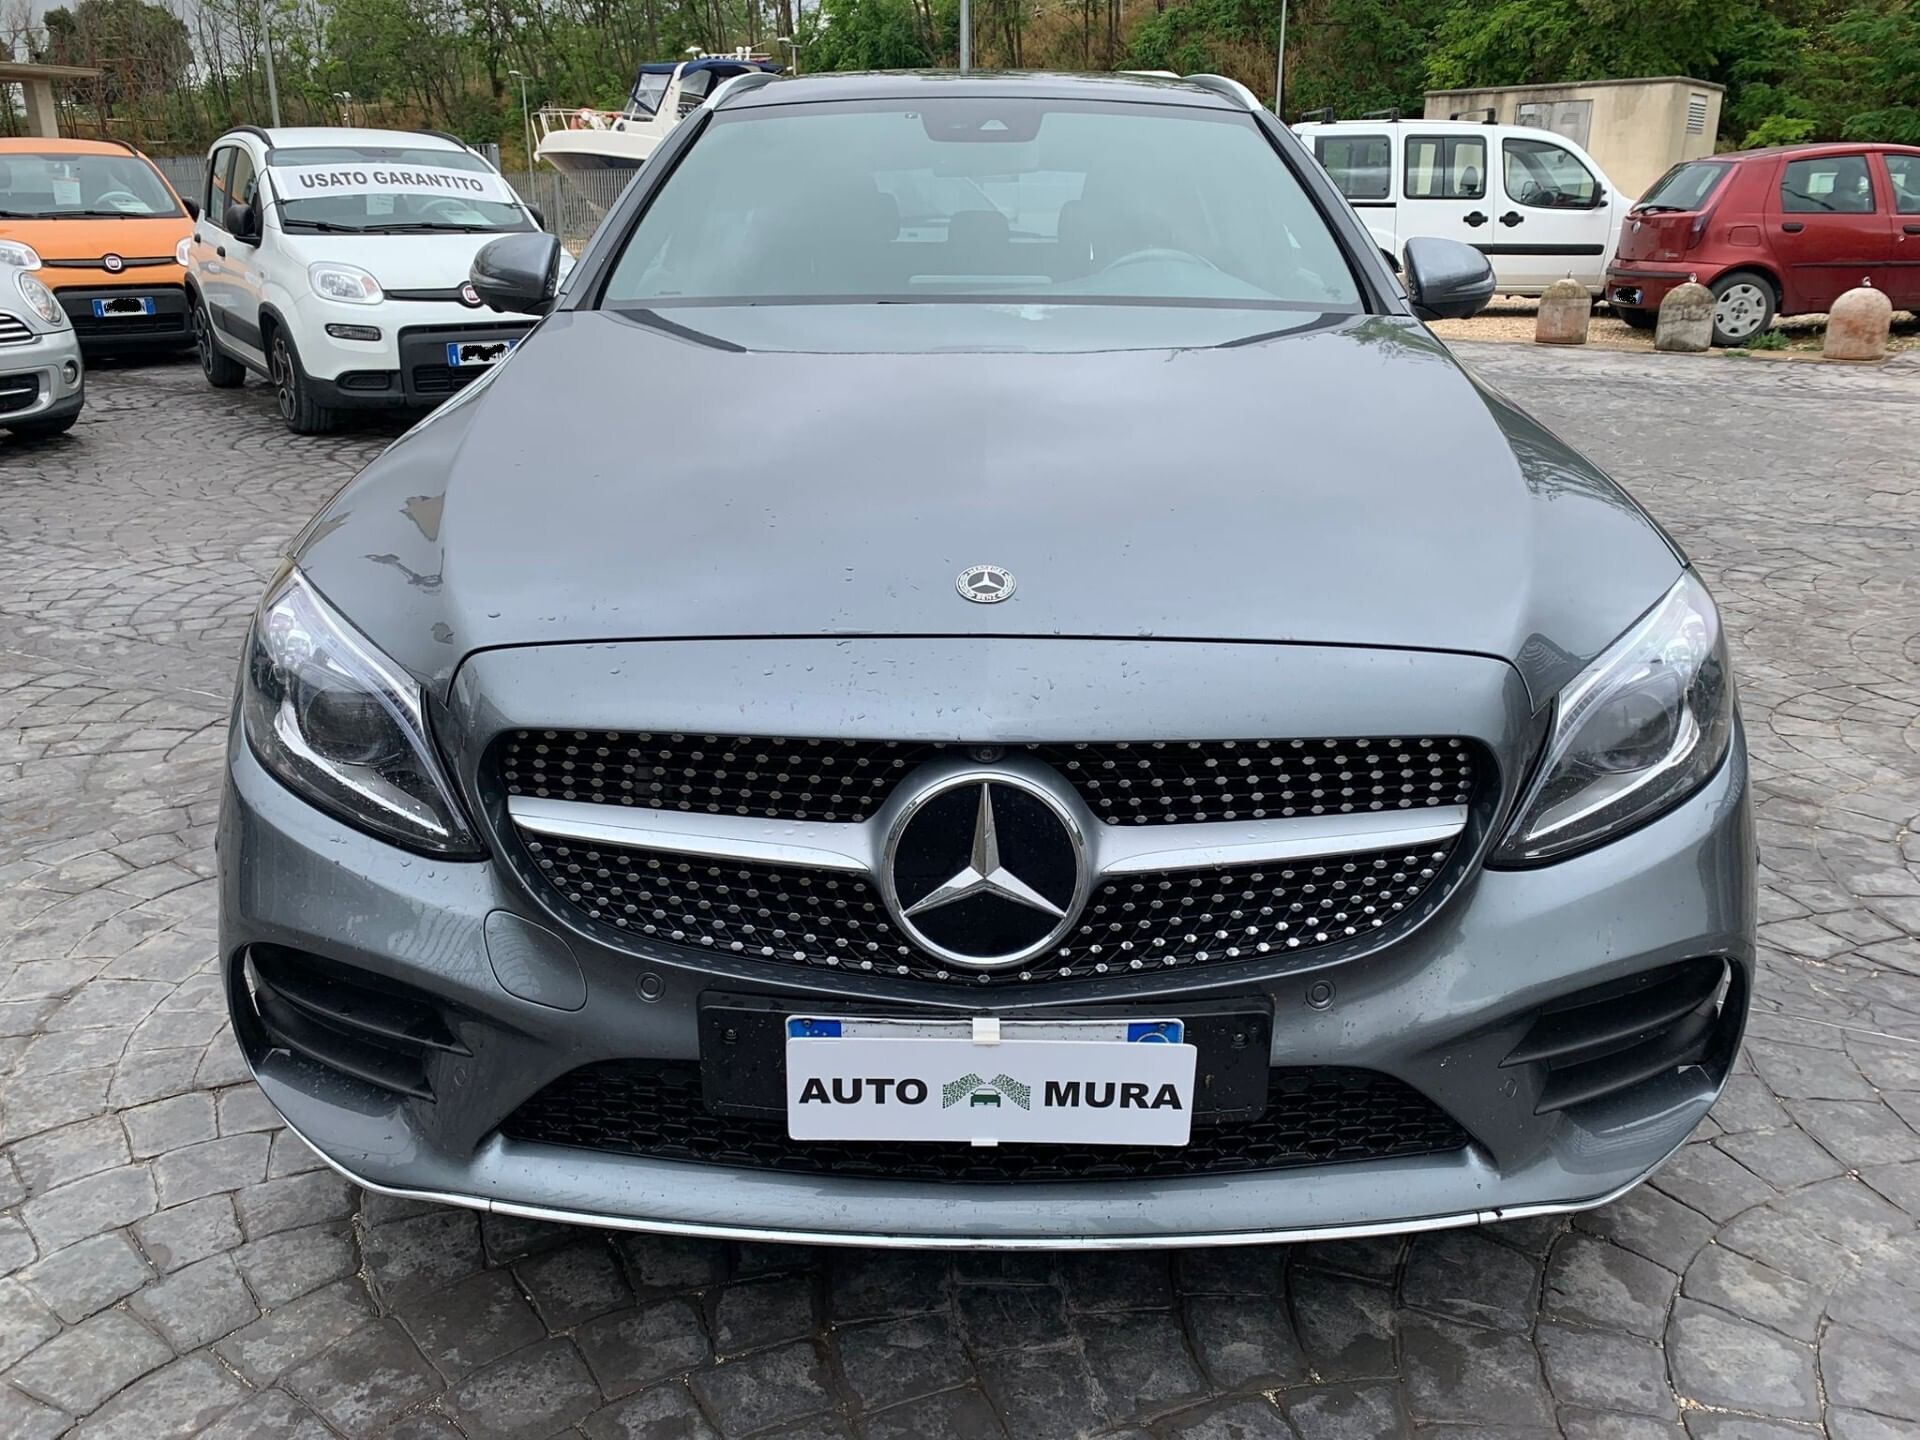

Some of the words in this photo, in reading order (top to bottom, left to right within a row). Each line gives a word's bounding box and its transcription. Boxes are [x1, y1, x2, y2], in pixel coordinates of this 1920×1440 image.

[299, 171, 368, 189] USATO
[373, 171, 484, 193] GARANTITO
[798, 1078, 928, 1105] AUTO
[1044, 1080, 1184, 1110] MURA
